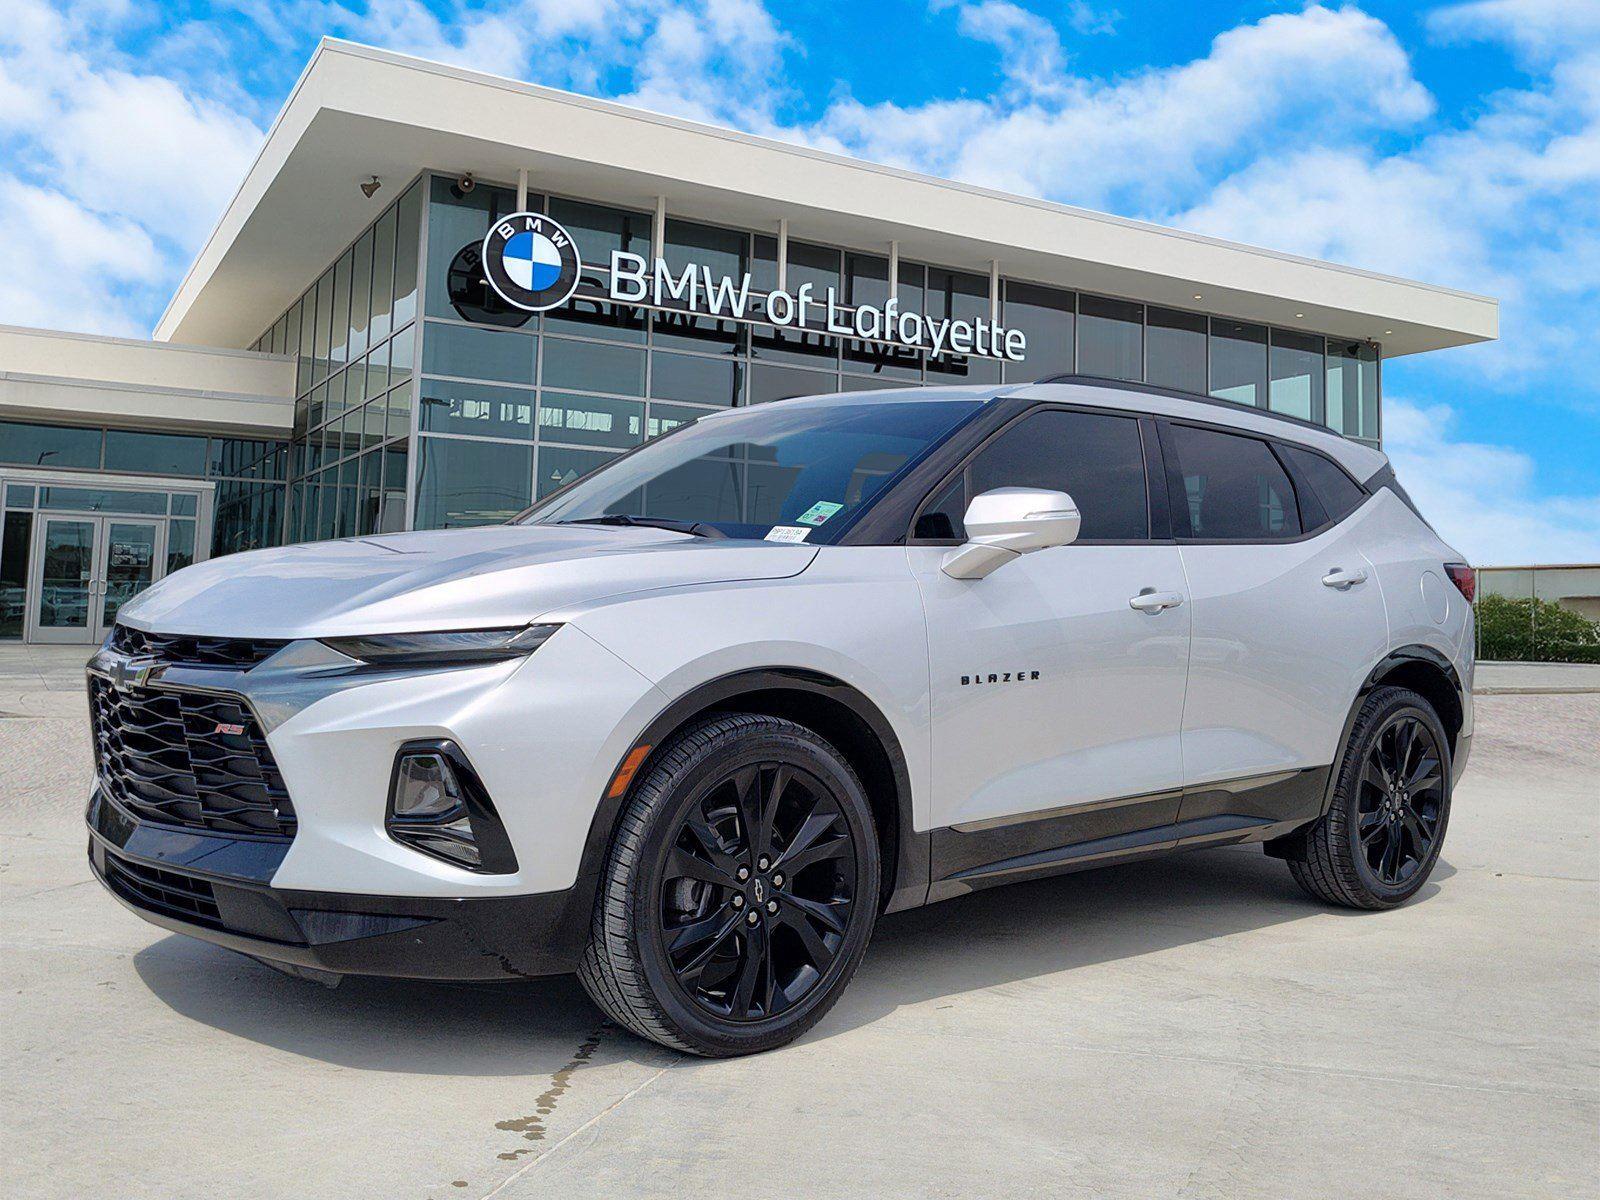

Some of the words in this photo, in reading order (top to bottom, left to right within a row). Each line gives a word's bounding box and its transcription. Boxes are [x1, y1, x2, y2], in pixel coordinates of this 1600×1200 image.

[497, 217, 569, 249] BMW
[610, 249, 751, 318] BMW
[767, 282, 813, 327] of
[826, 286, 1026, 361] Lafayette
[961, 670, 1040, 685] BLAZER
[214, 723, 245, 735] RS
